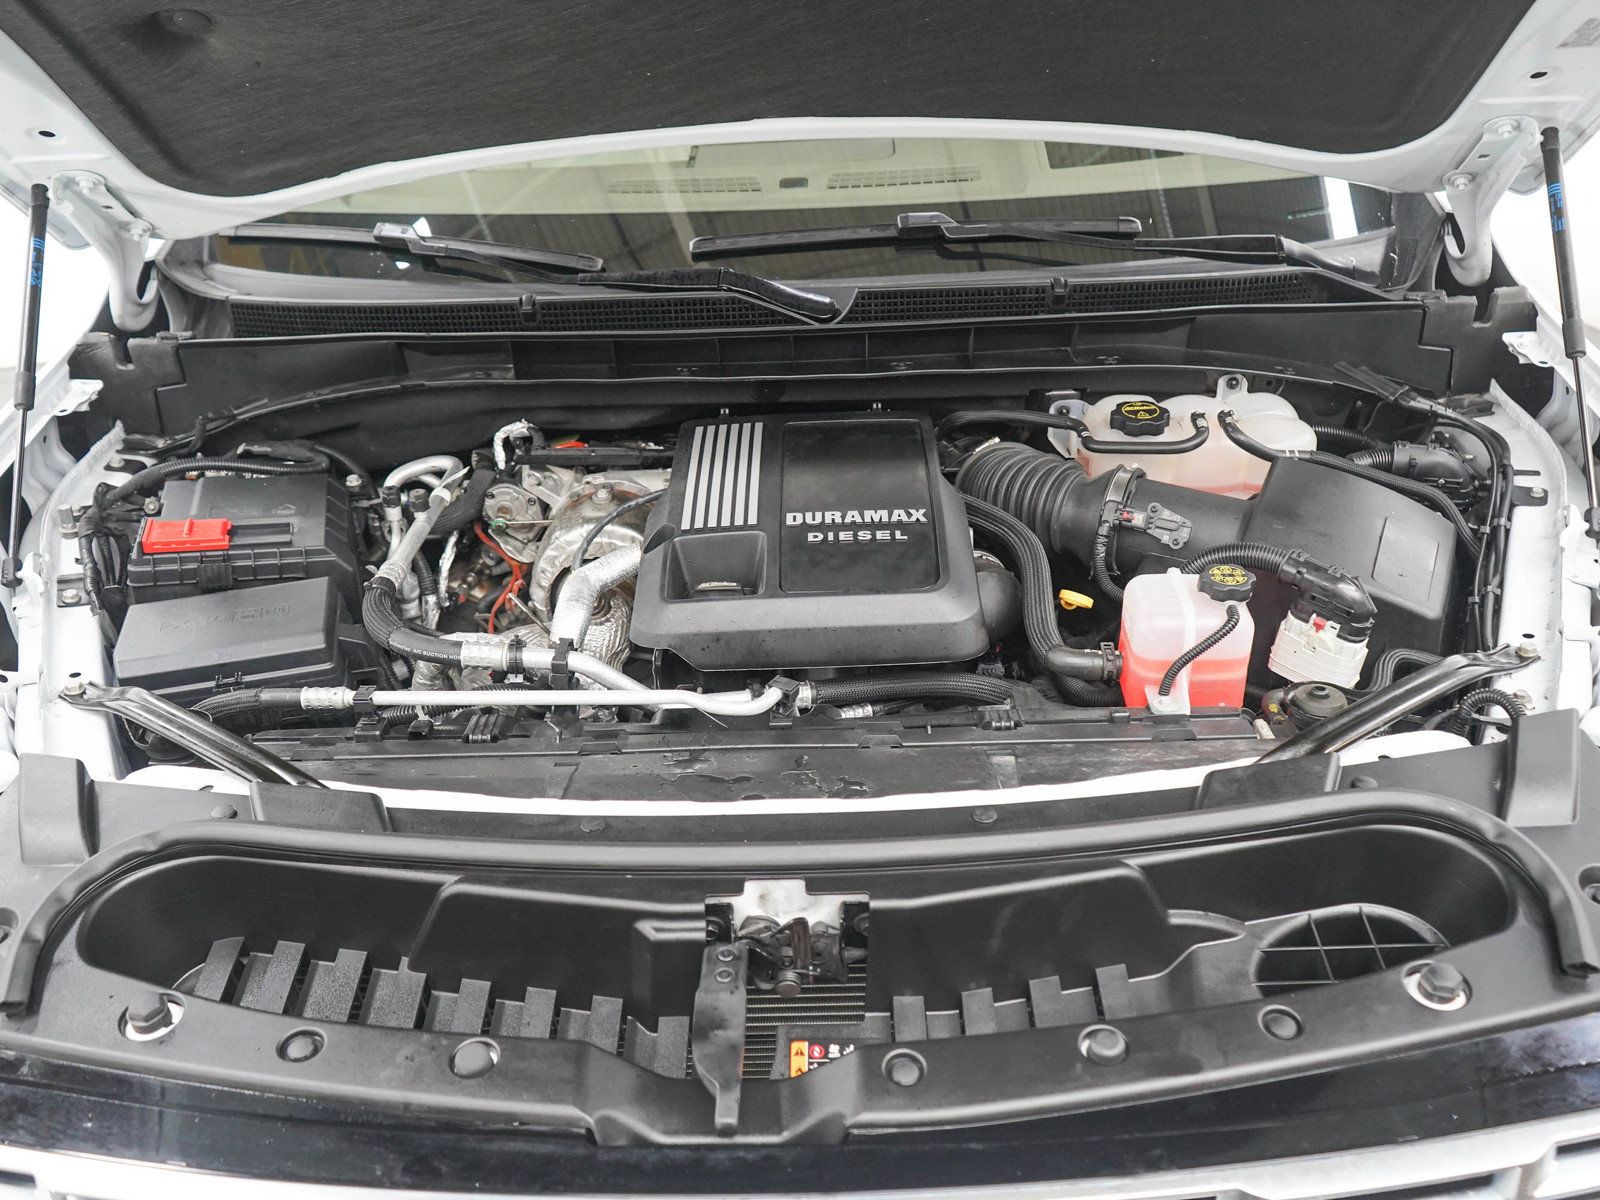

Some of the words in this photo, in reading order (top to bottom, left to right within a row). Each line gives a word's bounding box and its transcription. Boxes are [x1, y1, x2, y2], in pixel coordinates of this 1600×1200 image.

[785, 508, 928, 526] DURAMAX
[807, 530, 908, 543] DIESEL
[423, 650, 448, 659] SUCTION
